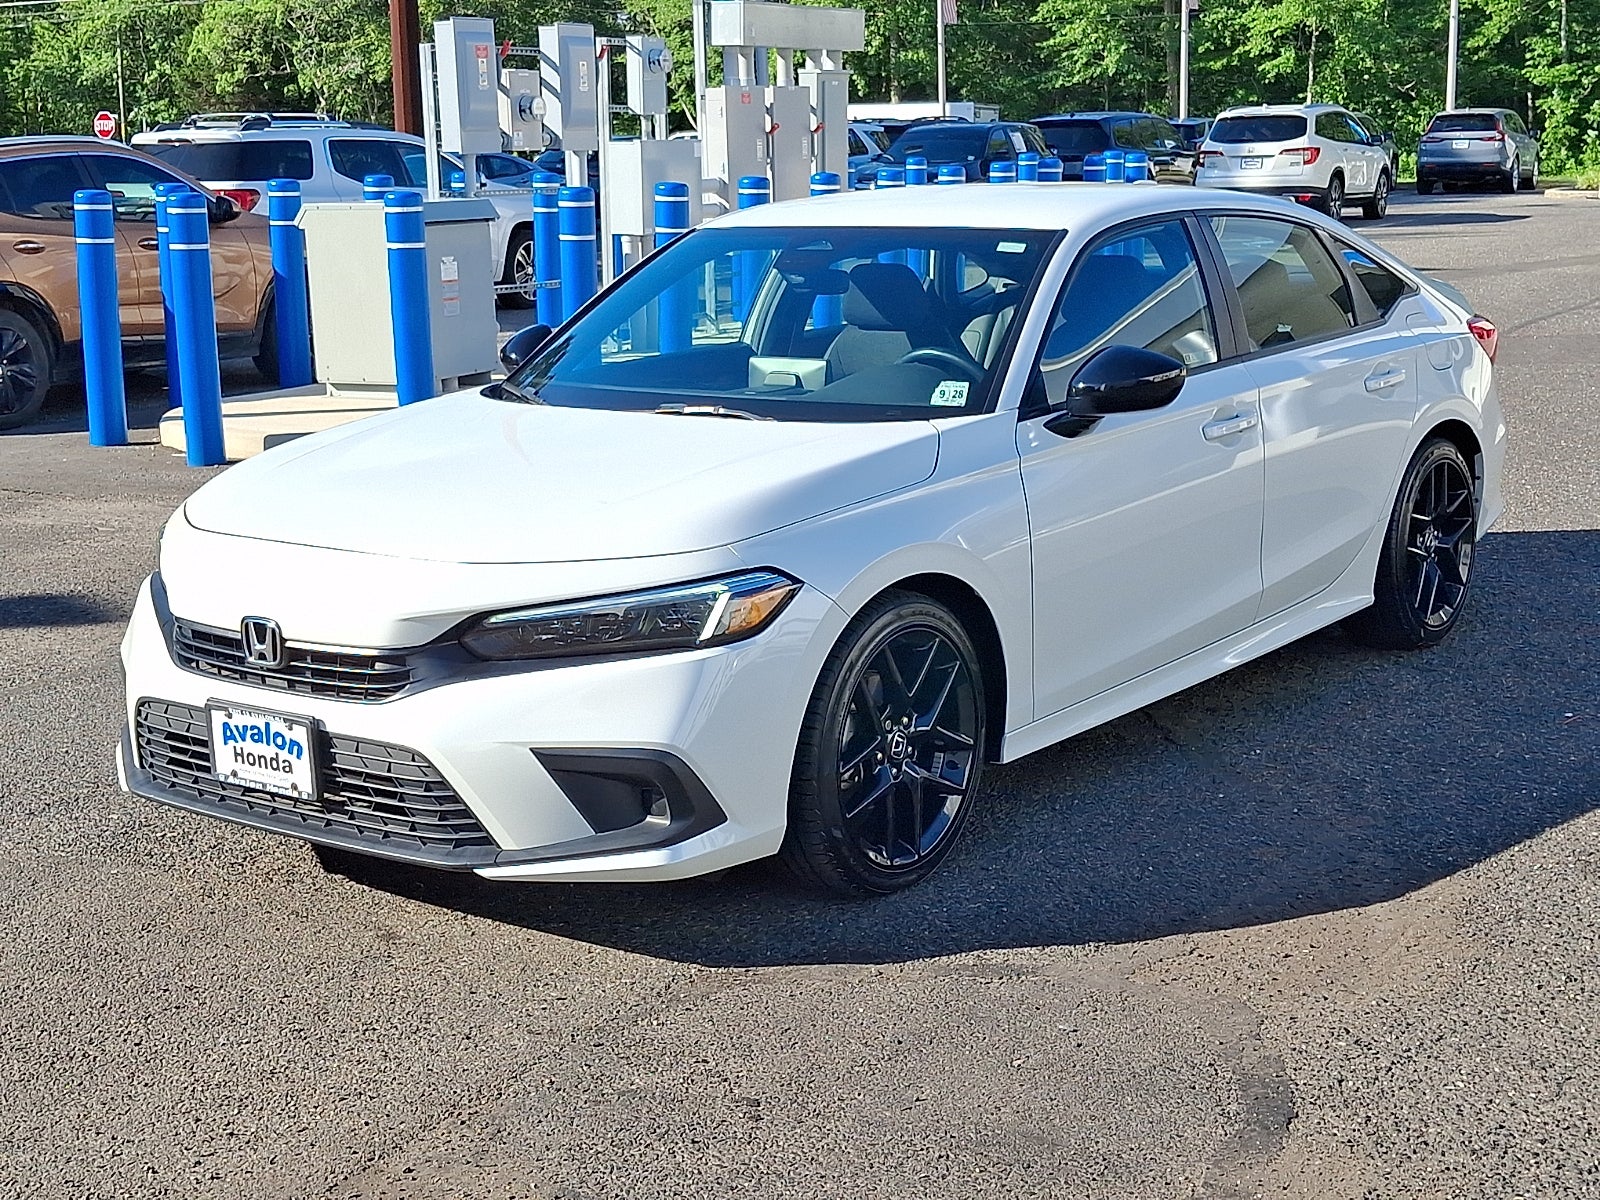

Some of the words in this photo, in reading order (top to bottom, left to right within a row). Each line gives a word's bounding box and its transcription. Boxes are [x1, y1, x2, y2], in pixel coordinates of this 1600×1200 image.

[95, 120, 113, 131] STOP
[939, 390, 946, 399] 9
[952, 390, 964, 399] 28
[222, 721, 303, 761] Avalon
[233, 745, 293, 774] Honda
